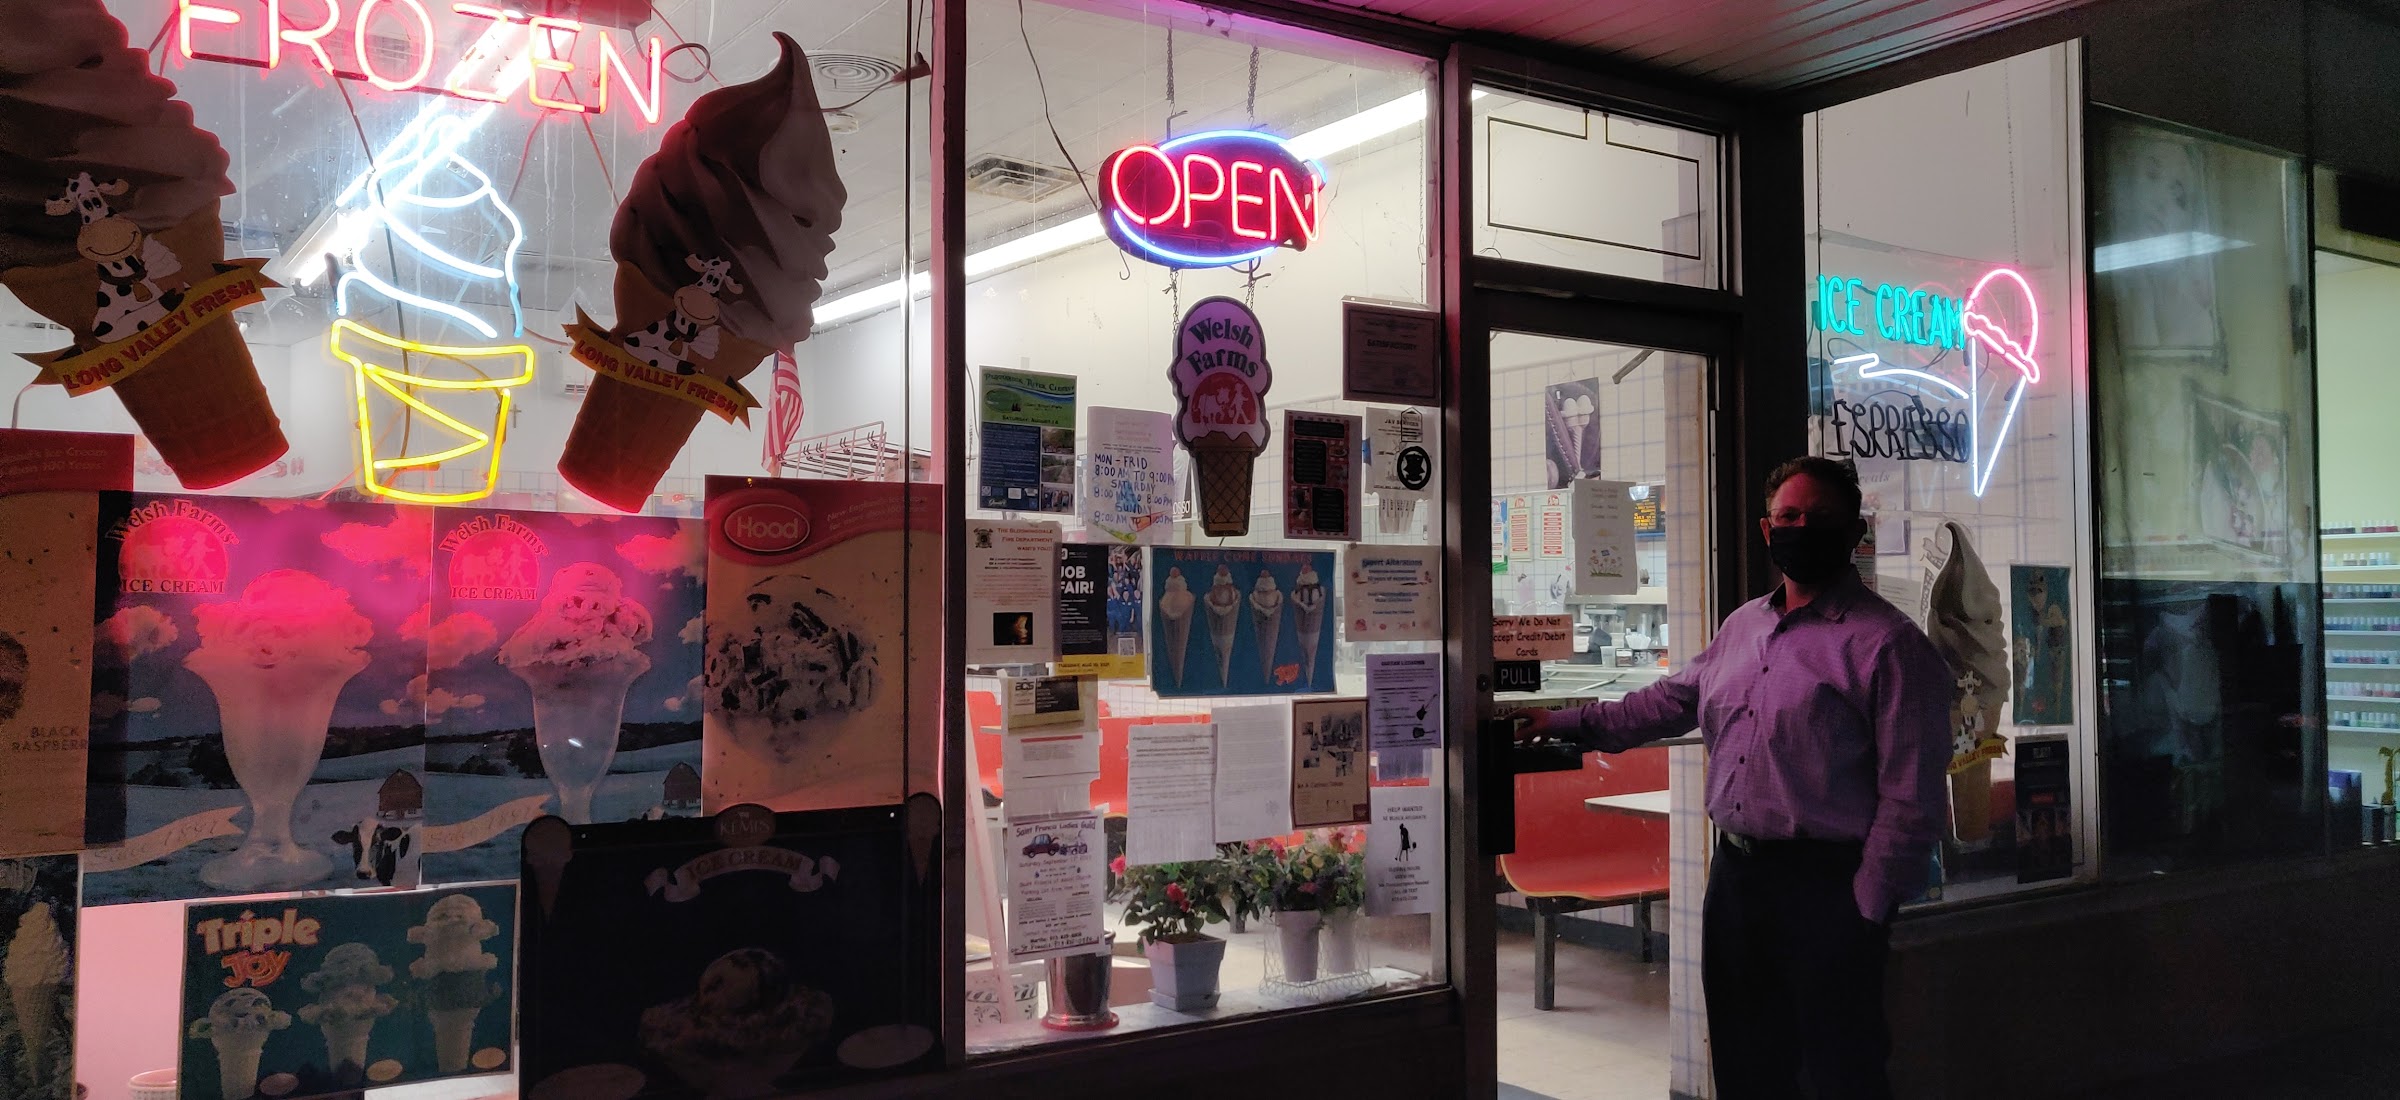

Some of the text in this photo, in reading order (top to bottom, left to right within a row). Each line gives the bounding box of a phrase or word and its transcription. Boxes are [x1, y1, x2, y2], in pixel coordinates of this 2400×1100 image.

[177, 0, 662, 124] FROZEN
[1110, 144, 1319, 242] OPEN
[1818, 274, 1965, 350] ICE CREAM
[63, 279, 257, 390] LONG VALLEY FRESH
[1188, 318, 1253, 349] Welsh
[1186, 348, 1259, 378] Farms
[575, 340, 739, 415] LONG VALLEY FRESH
[1826, 398, 1971, 462] ESPRESSO
[1094, 453, 1112, 465] MON
[1124, 456, 1148, 470] FRID
[1094, 464, 1115, 477] 8:00
[1117, 468, 1130, 478] AM
[1132, 471, 1145, 481] TO
[1094, 487, 1114, 498] 8:00
[1111, 479, 1155, 495] SATURDAY
[1115, 502, 1152, 515] SUNDAY
[105, 499, 236, 544] Welsh Farms
[1094, 511, 1114, 523] 8:00
[1116, 515, 1127, 524] AM
[438, 514, 547, 556] Welsh Farms
[737, 516, 799, 539] Hood
[1060, 565, 1086, 579] JOB
[122, 579, 225, 593] ICE CREAM
[451, 587, 537, 600] ICE CREAM
[1492, 617, 1561, 626] Sorry We Do Not
[1493, 632, 1566, 644] ccept Credit/Debit
[1516, 647, 1538, 656] Cards
[1500, 668, 1535, 686] PULL
[31, 726, 79, 738] BLACK
[12, 739, 87, 752] RASPBERR
[1016, 827, 1032, 837] Saint
[684, 850, 801, 881] ICE CREAM
[196, 907, 322, 956] Triple
